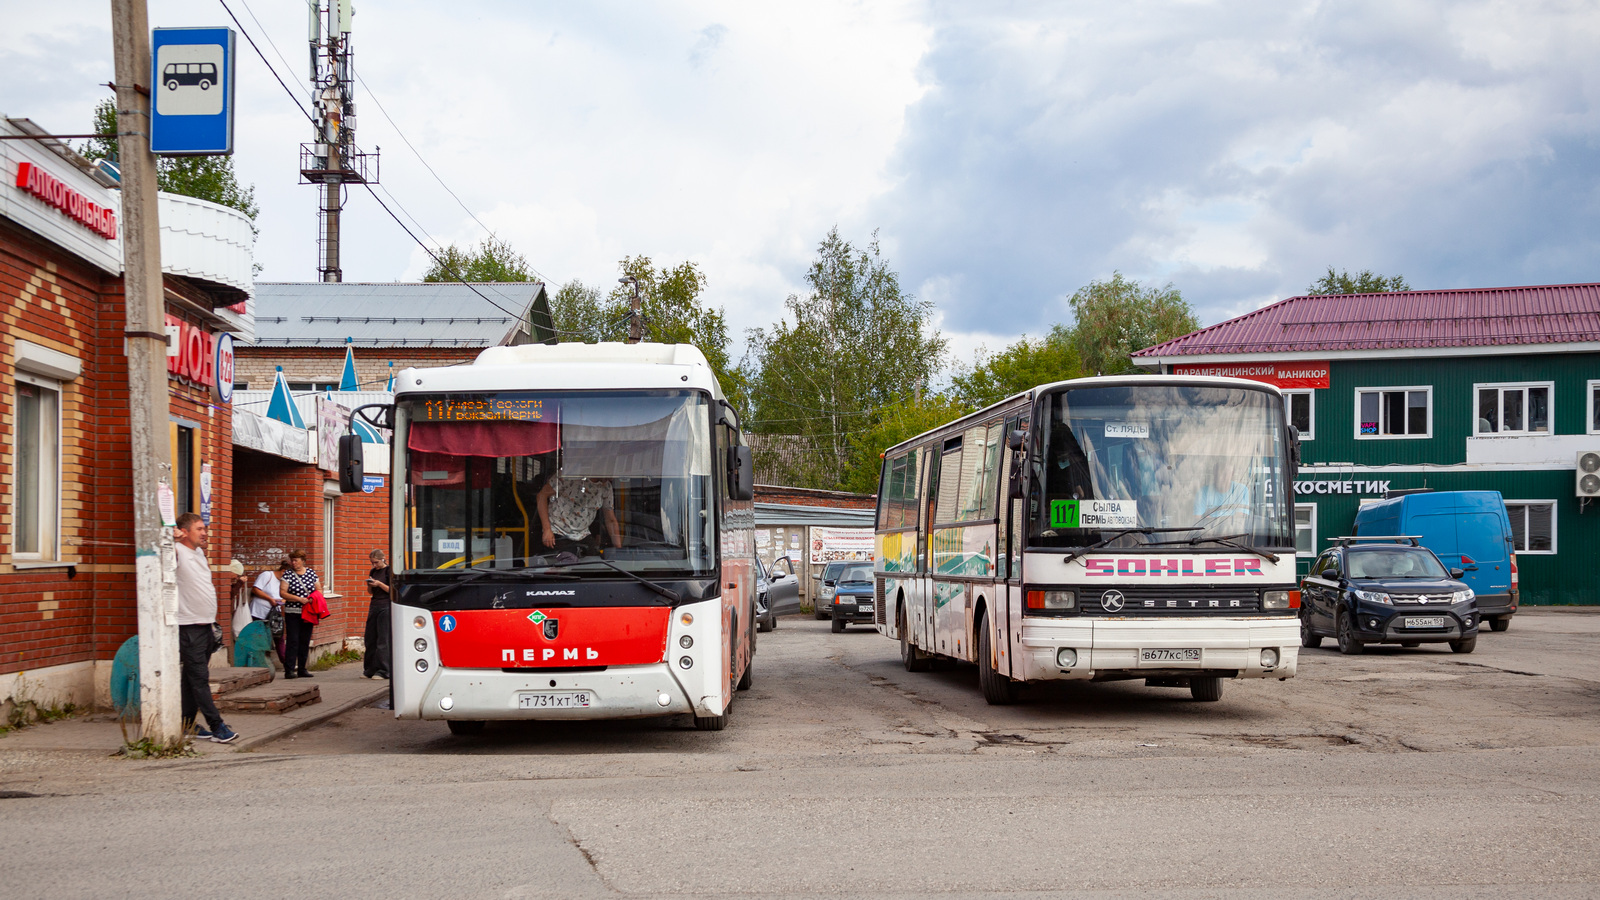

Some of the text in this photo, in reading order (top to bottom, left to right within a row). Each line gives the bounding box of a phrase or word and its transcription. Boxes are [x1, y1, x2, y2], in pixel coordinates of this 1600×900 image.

[17, 163, 117, 239] АЛКОГОЛЬНЫЙ
[1176, 365, 1327, 379] ПАРАМЕДИЦИНСКИЙ МАНИКЮР
[503, 409, 543, 421] Пермь
[1105, 425, 1148, 435] Ст. ЛЯДЫ
[1092, 501, 1122, 513] СЫЛВА
[1054, 503, 1076, 524] 117
[1081, 513, 1107, 525] ПЕРМЬ
[442, 541, 461, 550] ВХОД
[1085, 558, 1265, 577] SOHLER
[526, 589, 576, 597] KAMAZ
[1144, 600, 1241, 608] SETRA
[501, 647, 599, 662] ПЕРМЬ
[1144, 650, 1182, 660] В677КС
[524, 694, 586, 707] Т731ХТ 18
